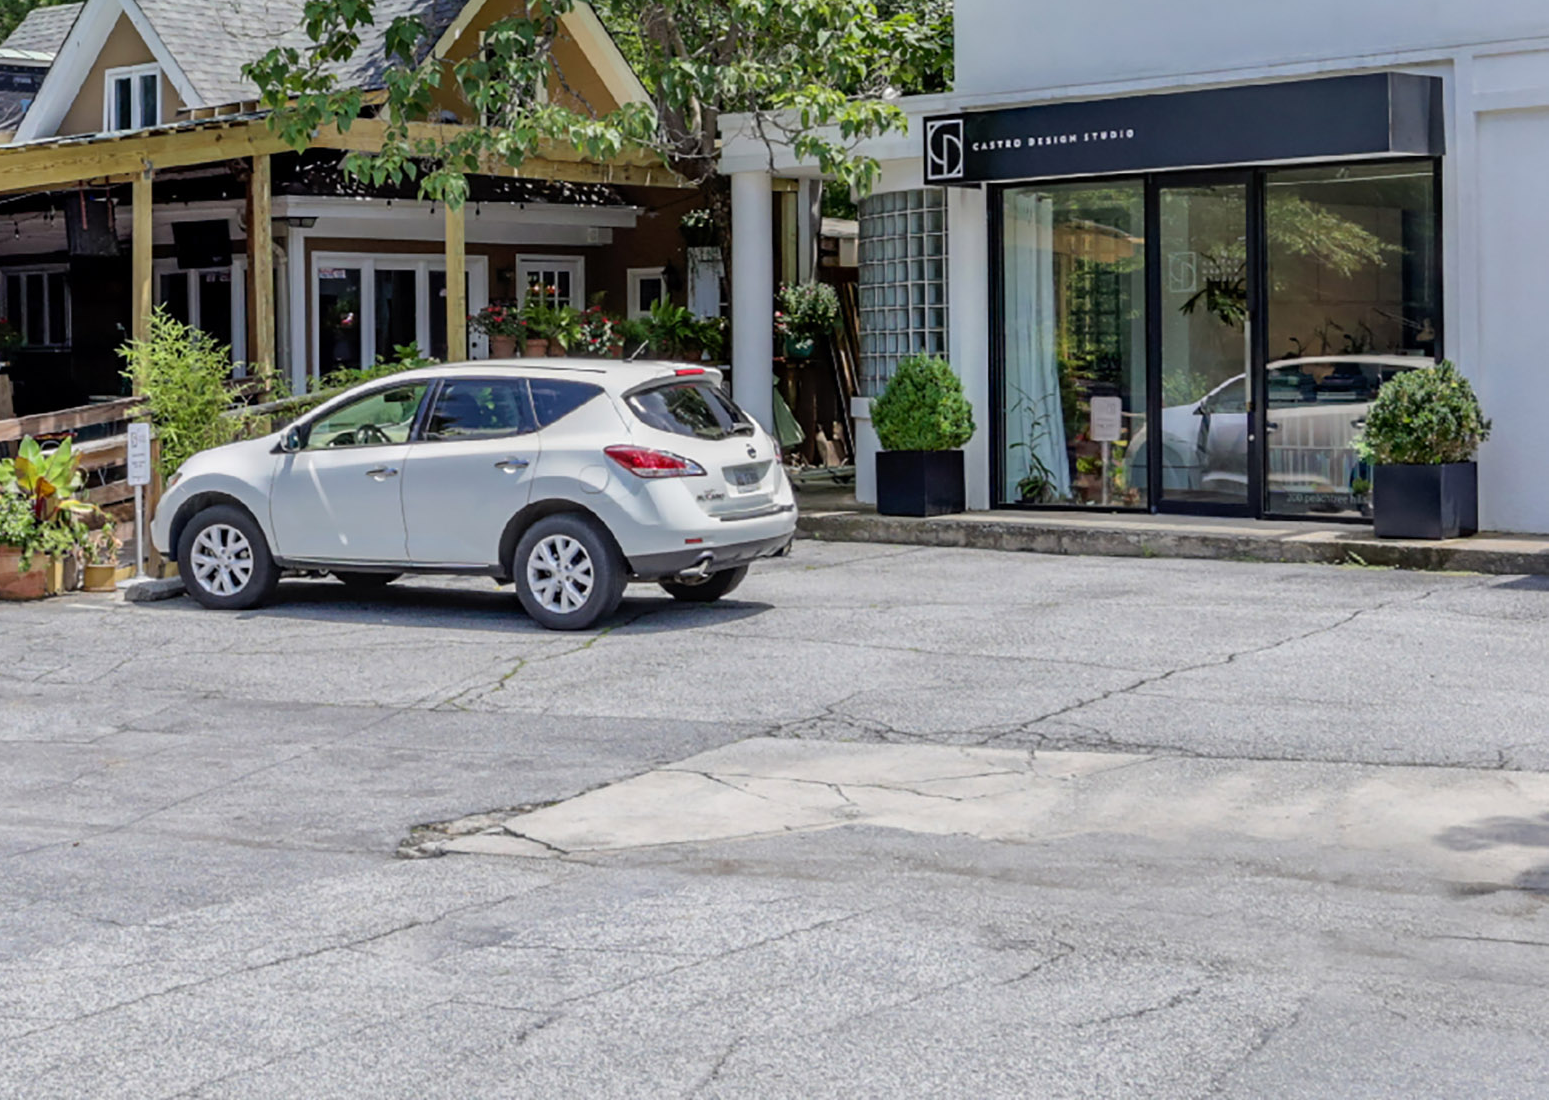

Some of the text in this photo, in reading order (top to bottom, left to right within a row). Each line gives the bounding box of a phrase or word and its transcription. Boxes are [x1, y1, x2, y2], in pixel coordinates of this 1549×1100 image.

[972, 128, 1134, 151] CASTRO DESIGN STUDIO
